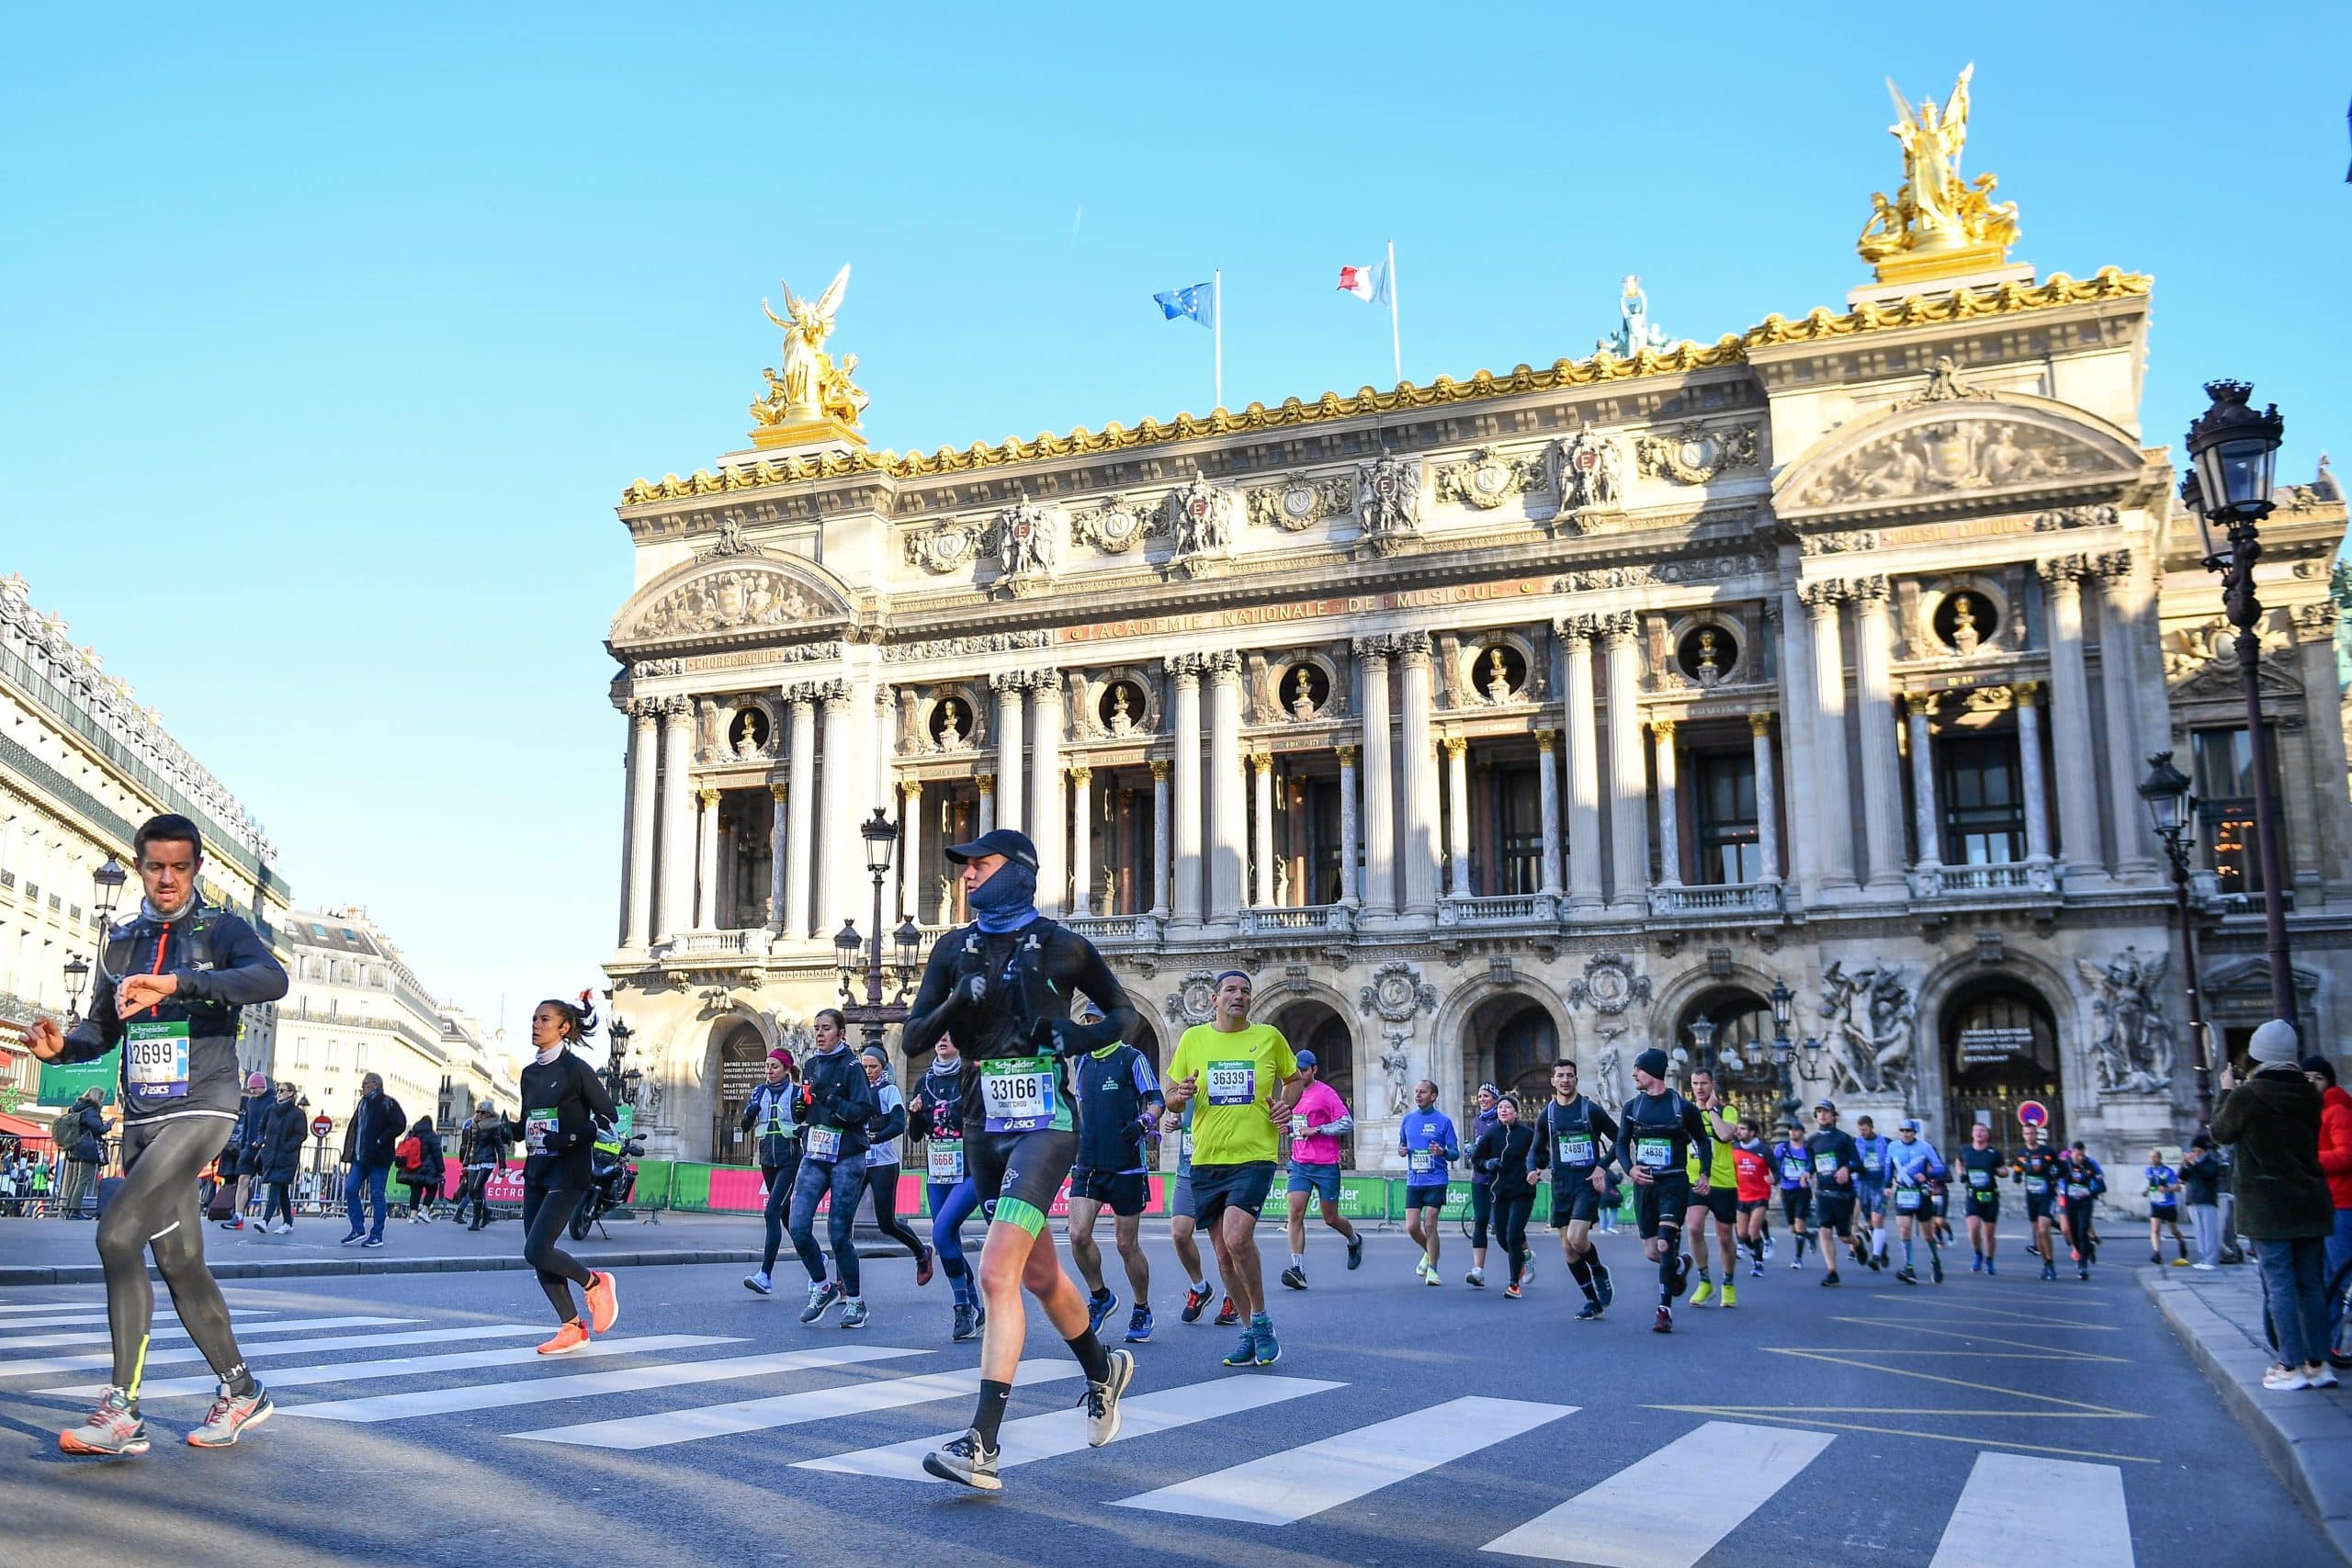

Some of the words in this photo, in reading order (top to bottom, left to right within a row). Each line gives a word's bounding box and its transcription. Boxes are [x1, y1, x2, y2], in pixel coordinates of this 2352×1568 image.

[1579, 455, 1590, 468] E
[1380, 479, 1390, 492] E
[1193, 501, 1202, 514] E
[1017, 523, 1028, 537] E
[1099, 615, 1205, 638] ACADEMIE
[1223, 602, 1328, 626] NATIONALE
[1349, 596, 1376, 612] DE
[1396, 585, 1498, 608] MUSIQUE
[1213, 1071, 1245, 1085] 36339
[990, 1078, 1036, 1100] 33166
[1564, 1143, 1585, 1154] 24897
[931, 1154, 954, 1166] 16668
